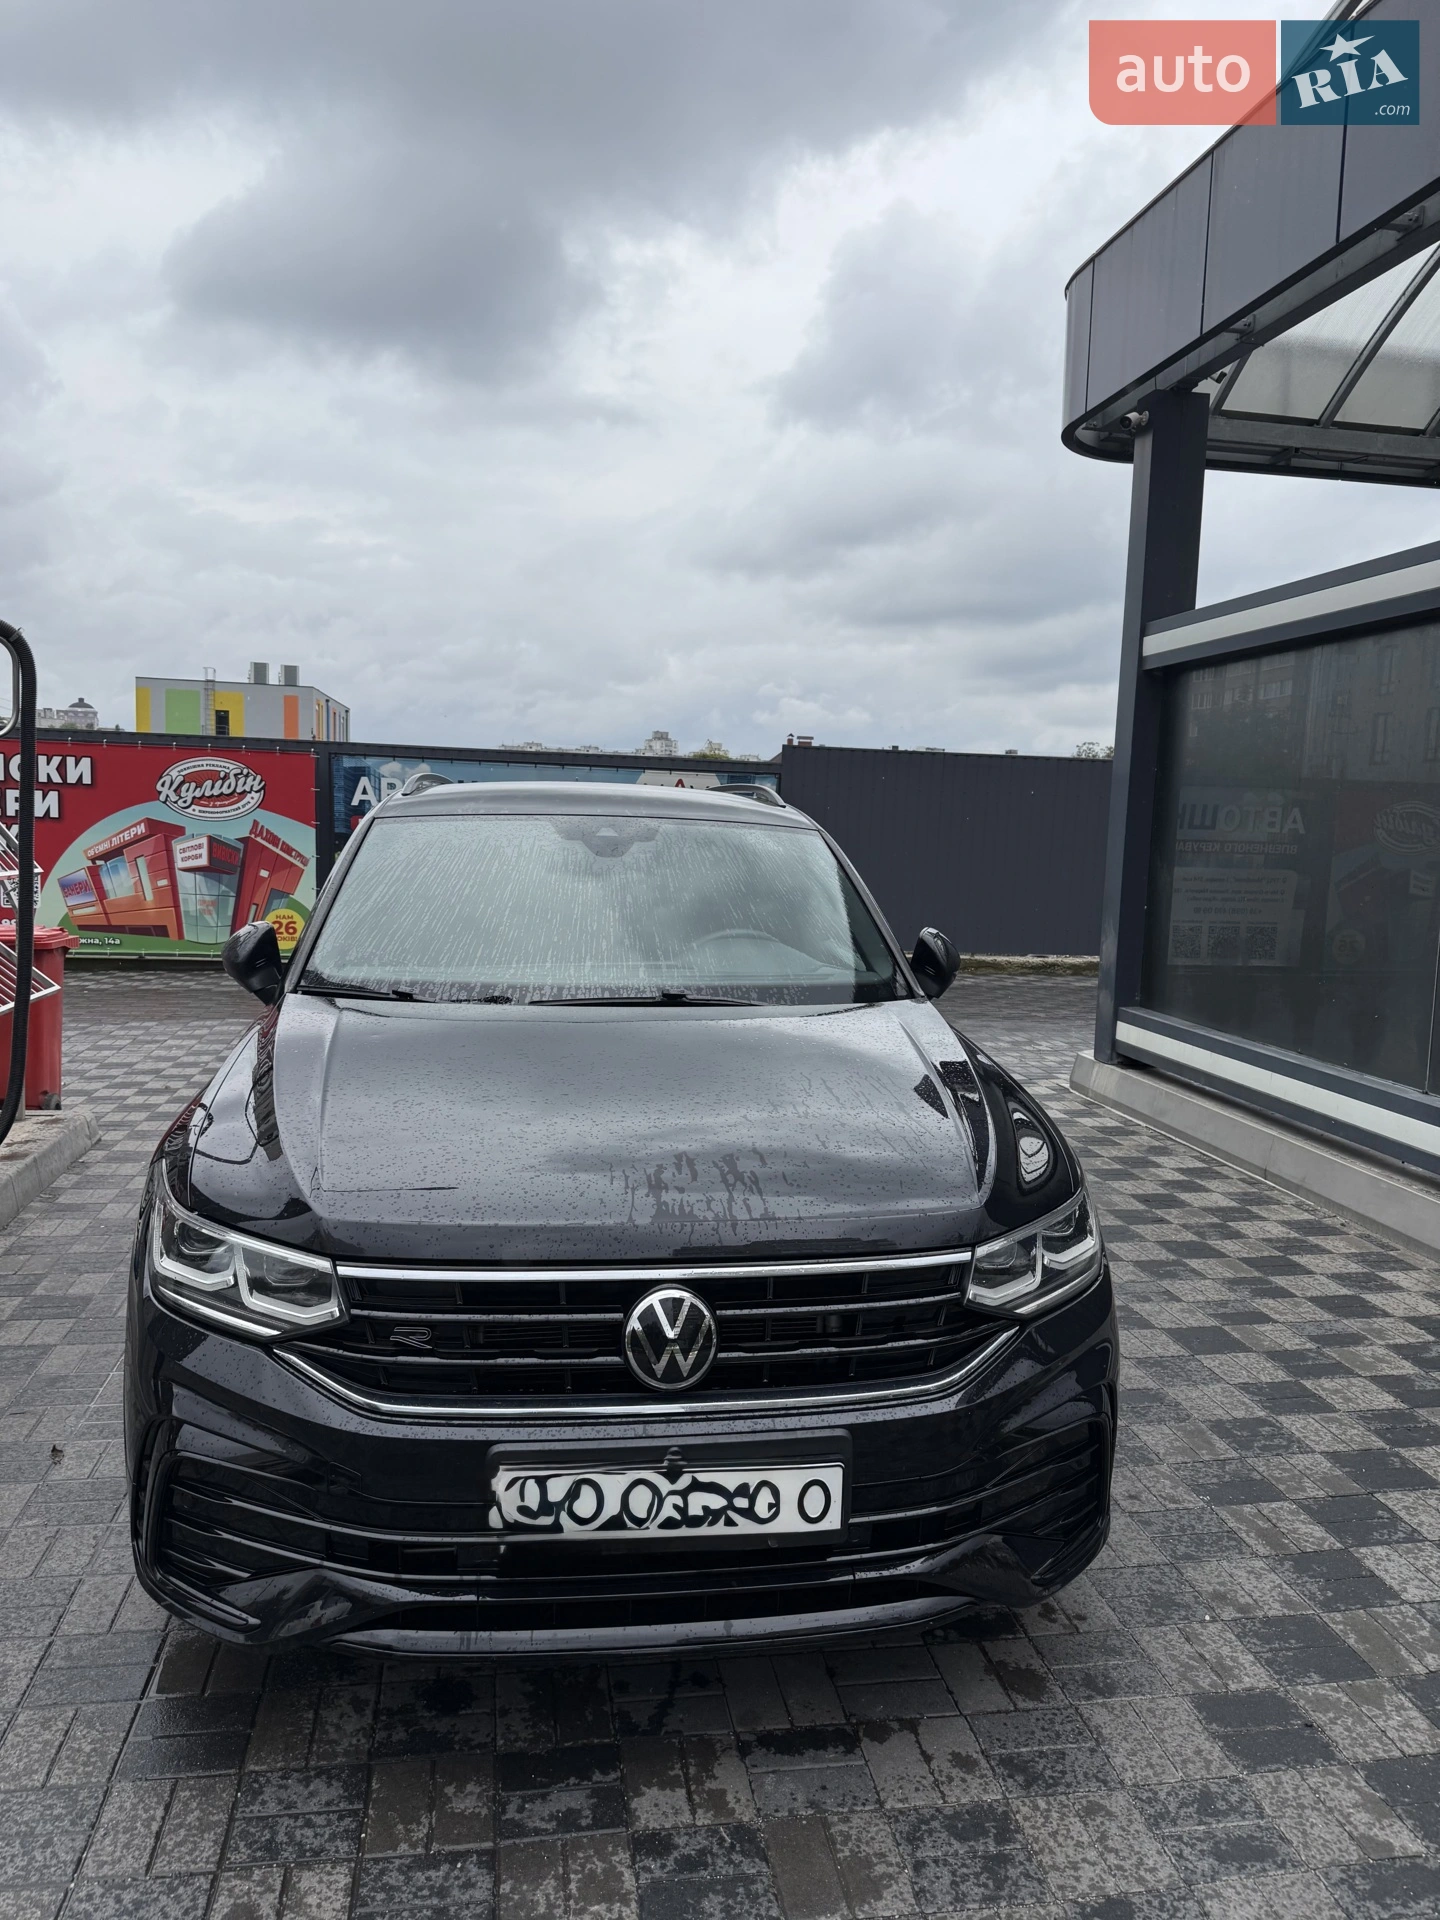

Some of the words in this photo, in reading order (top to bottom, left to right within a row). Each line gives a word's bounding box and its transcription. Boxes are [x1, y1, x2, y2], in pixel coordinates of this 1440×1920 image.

[156, 767, 266, 808] Кулібін
[111, 822, 146, 847] ЛІТЕРИ
[179, 843, 205, 855] СВІТЛОВІ
[181, 853, 203, 862] КОРОБИ
[272, 920, 298, 936] 26
[79, 937, 102, 945] жна,
